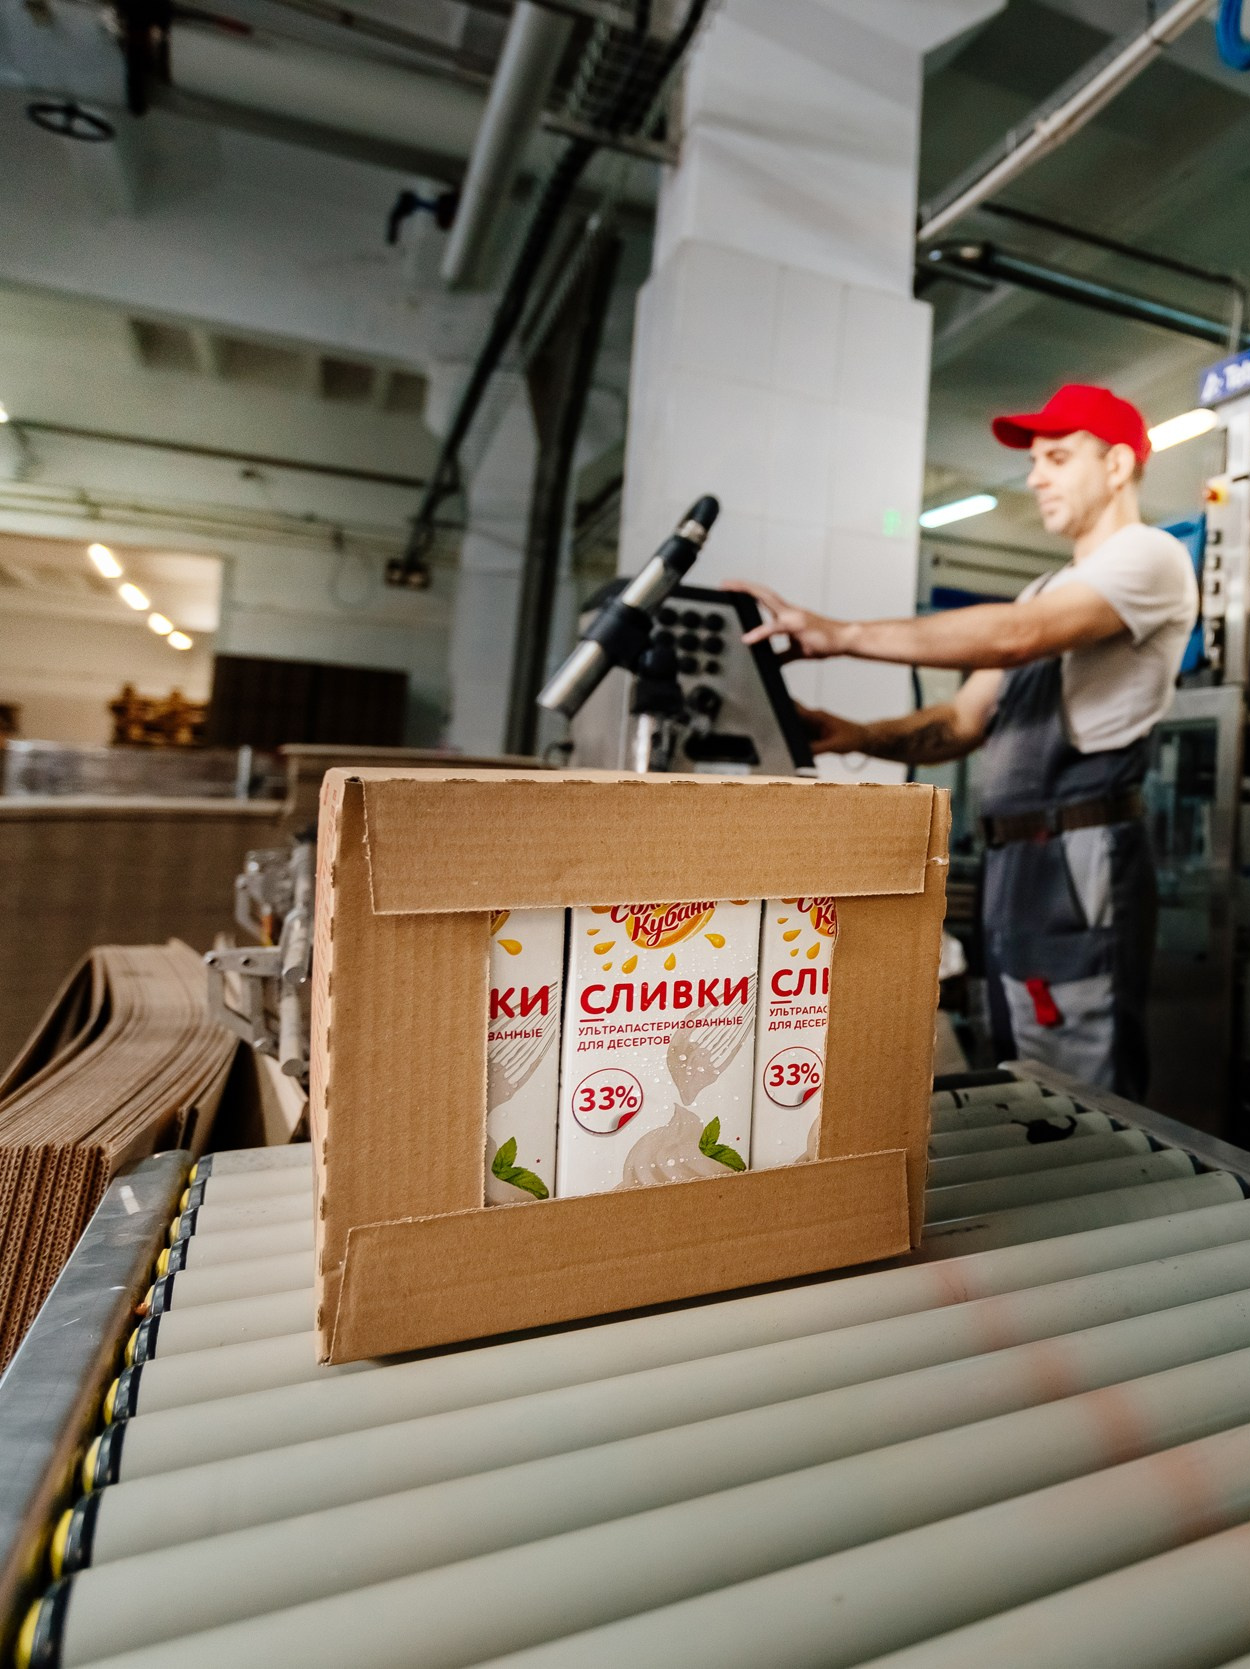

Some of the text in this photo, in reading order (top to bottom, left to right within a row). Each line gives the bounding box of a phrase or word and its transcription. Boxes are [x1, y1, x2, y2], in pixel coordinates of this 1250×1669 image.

[489, 985, 549, 1020] КИ
[580, 976, 749, 1015] СЛИВКИ
[578, 1016, 743, 1037] УЛЬТРАПАСТЕРИЗОВАННЫЕ
[768, 1020, 792, 1032] ДЛЯ
[577, 1040, 604, 1052] ДЛЯ
[769, 1062, 821, 1087] 33%
[578, 1085, 638, 1112] 33%
